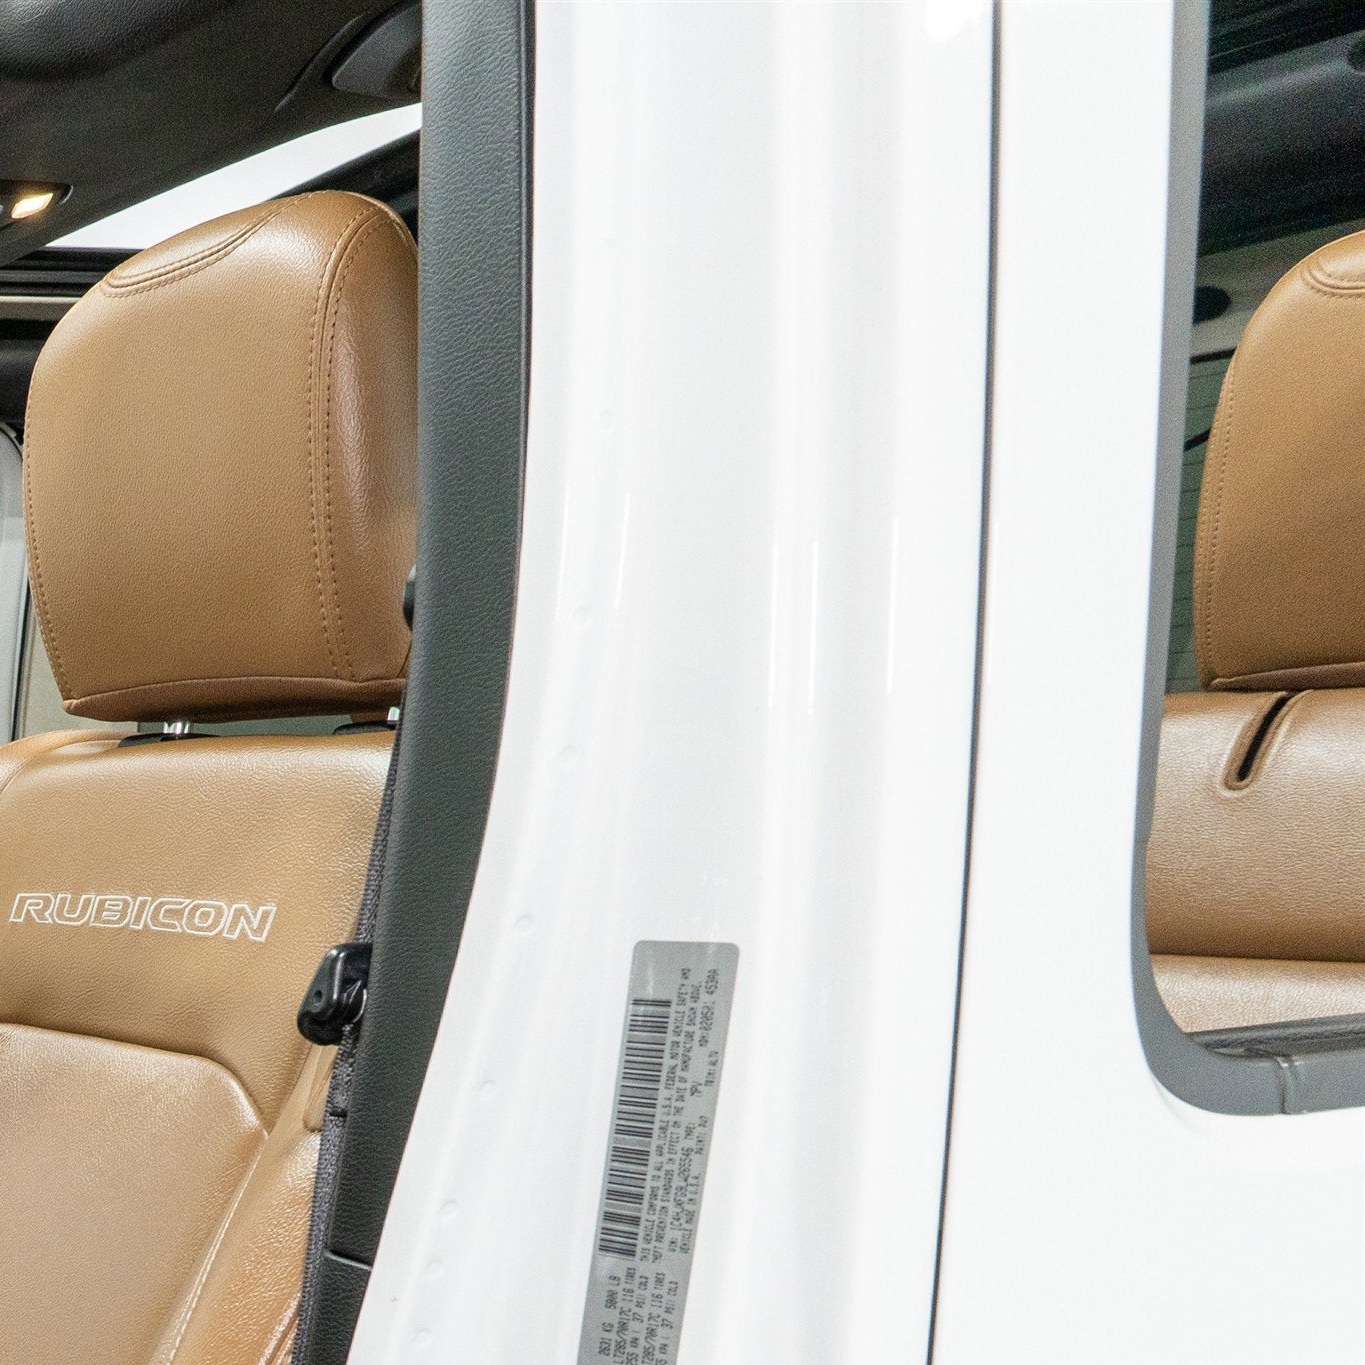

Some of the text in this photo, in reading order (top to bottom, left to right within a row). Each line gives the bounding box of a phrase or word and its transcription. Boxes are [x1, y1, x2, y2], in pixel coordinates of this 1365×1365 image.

[8, 892, 277, 943] RUBICON
[607, 1274, 620, 1286] LB
[604, 1288, 618, 1310] 5800
[621, 1287, 634, 1302] 116
[649, 1292, 663, 1308] 116
[631, 1311, 644, 1323] 37
[660, 1317, 674, 1329] 37
[601, 1321, 614, 1333] KG
[612, 1306, 631, 1364] LT285/70R17C
[597, 1336, 611, 1356] 2631
